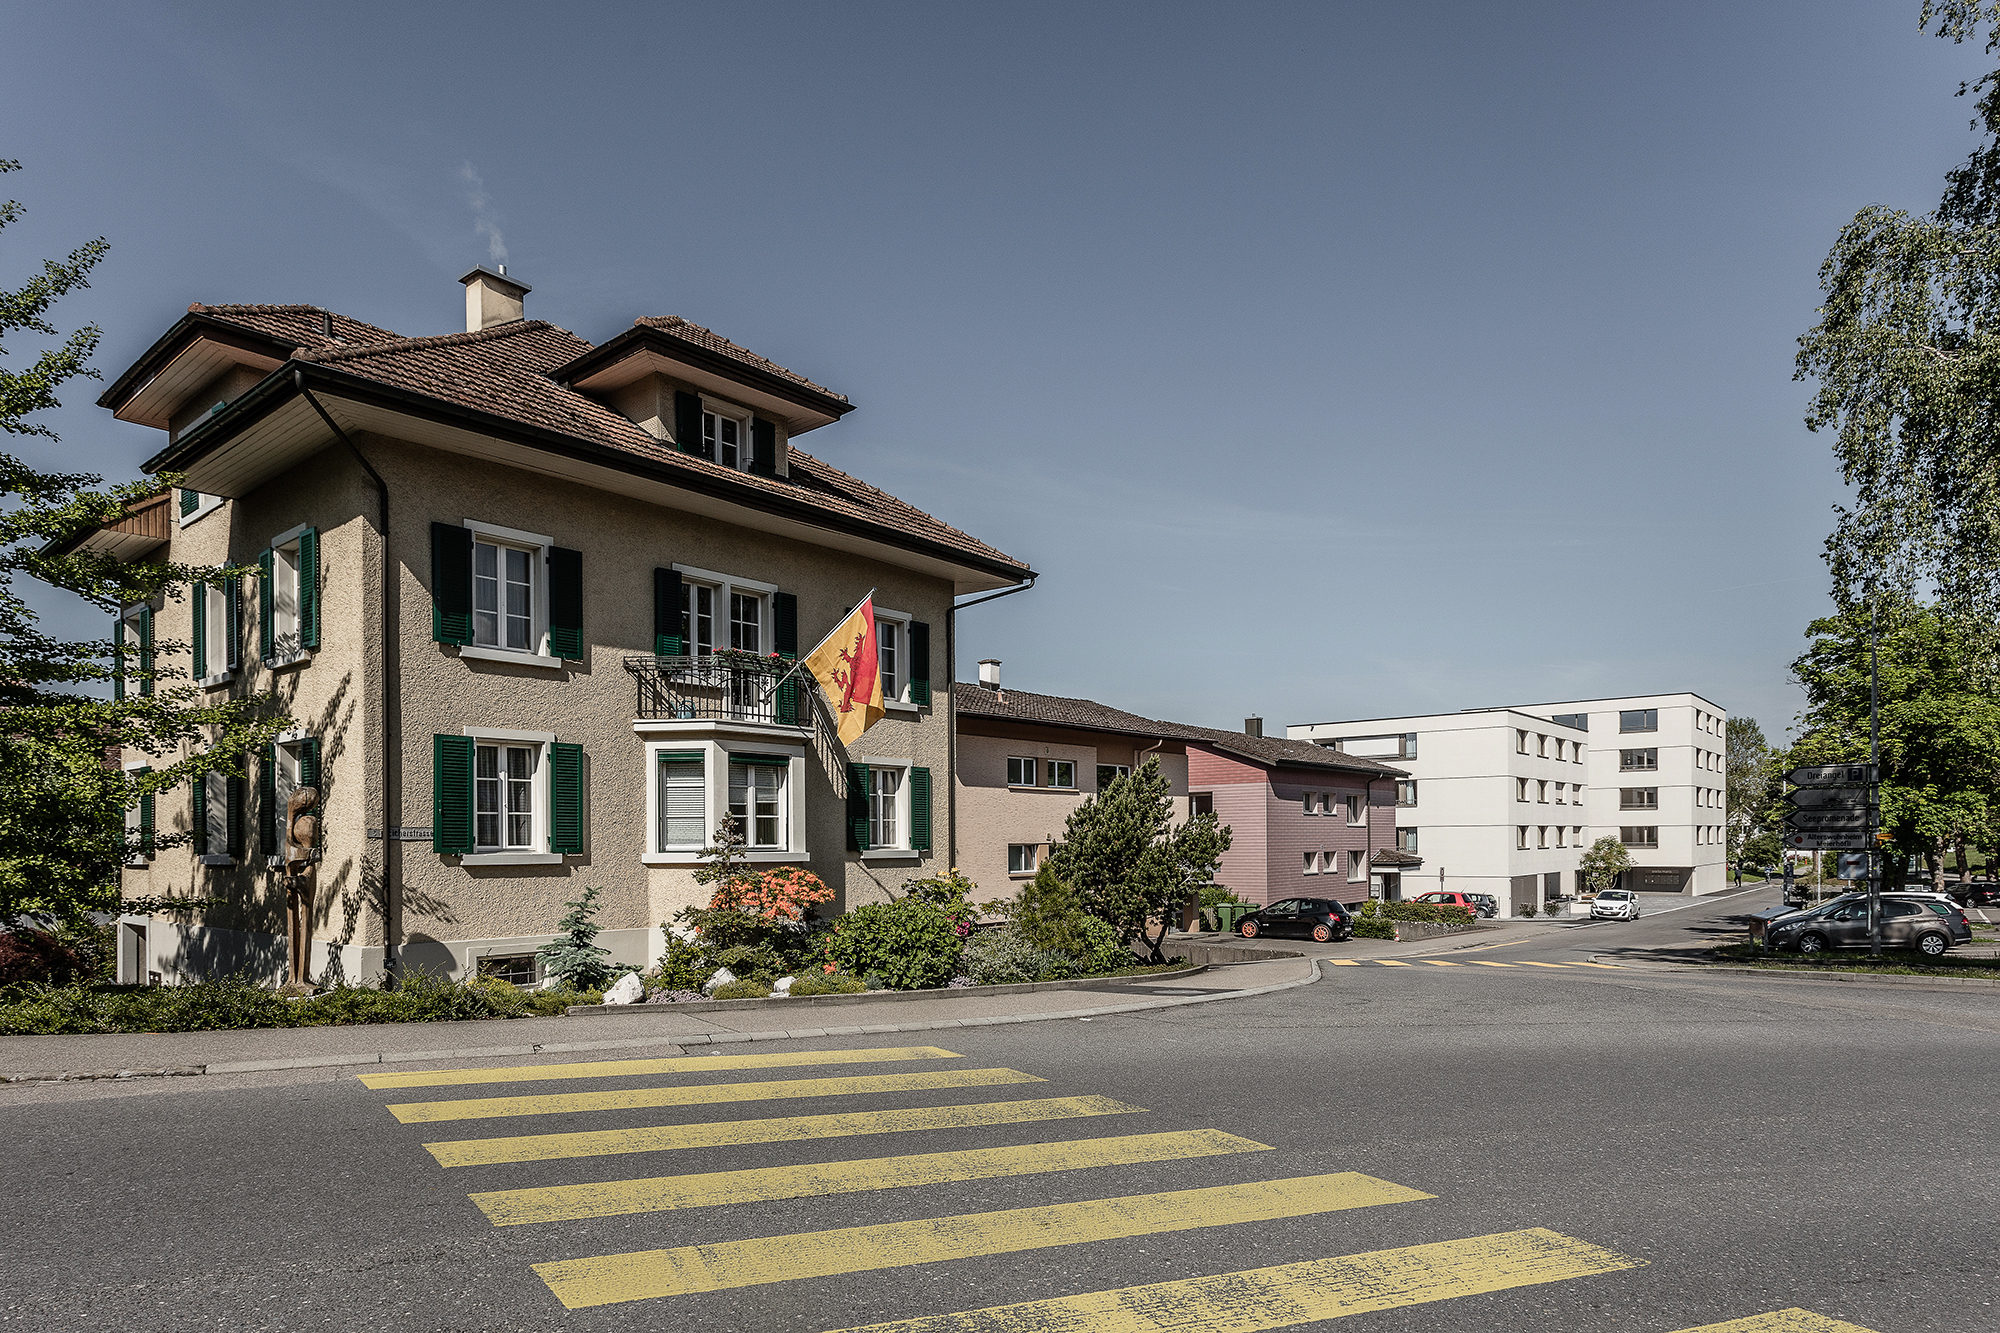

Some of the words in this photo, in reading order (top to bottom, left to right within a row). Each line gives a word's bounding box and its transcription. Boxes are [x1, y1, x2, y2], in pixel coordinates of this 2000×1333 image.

[1807, 771, 1844, 779] Dreiangel
[1852, 769, 1859, 779] P
[1803, 814, 1859, 823] Seepromenade
